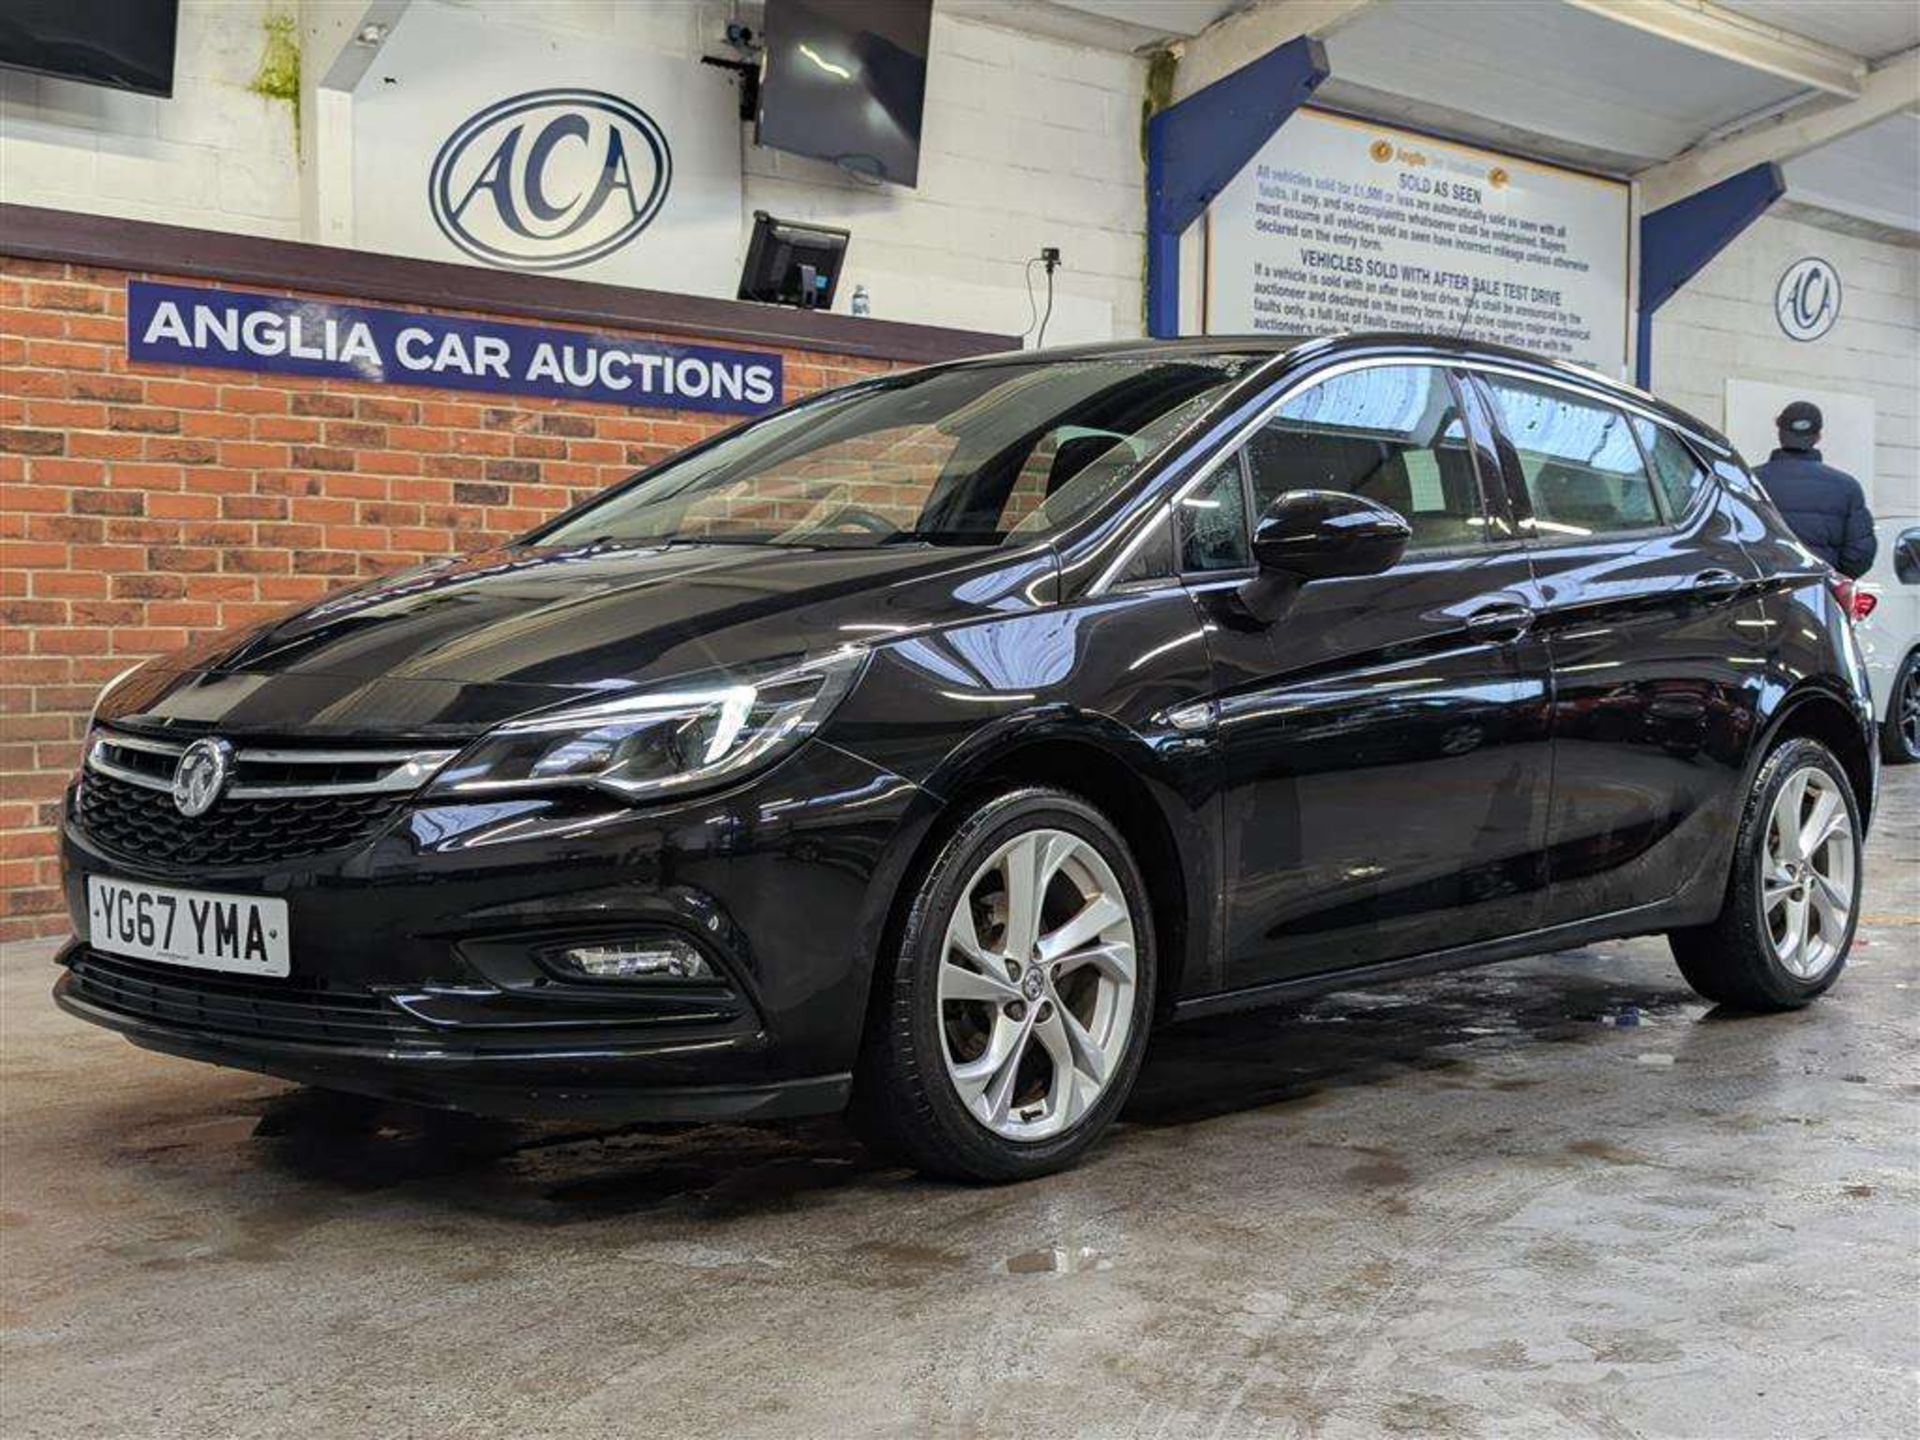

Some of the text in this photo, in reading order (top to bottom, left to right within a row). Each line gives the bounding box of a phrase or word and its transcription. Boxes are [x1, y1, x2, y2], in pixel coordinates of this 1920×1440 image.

[451, 113, 641, 241] ACA
[1272, 170, 1312, 188] vehicles
[1315, 179, 1335, 191] sold
[1337, 181, 1351, 194] for
[1397, 191, 1415, 207] less
[1417, 200, 1430, 211] are
[1432, 203, 1486, 225] automatically
[1488, 213, 1506, 225] sold
[1507, 218, 1517, 228] as
[1520, 220, 1538, 232] seen
[1540, 224, 1555, 237] with
[1557, 225, 1566, 237] all
[1399, 172, 1482, 204] SOLD AS SEEN
[1256, 219, 1298, 236] declared
[1301, 228, 1313, 238] on
[1316, 228, 1330, 242] the
[1333, 231, 1357, 249] entry
[1256, 202, 1589, 272] must assume all vehicles sold as seen have incorrect mileage unless otherwise
[1292, 189, 1299, 201] if
[1323, 196, 1341, 210] and
[1343, 201, 1355, 213] no
[1357, 204, 1405, 222] complaints
[1408, 213, 1456, 231] whatsoever
[1459, 222, 1478, 235] shall
[1479, 227, 1490, 238] be
[1254, 261, 1262, 275] If
[1265, 267, 1271, 277] a
[1273, 268, 1307, 283] vehicle
[1309, 272, 1318, 284] is
[1321, 275, 1341, 287] sold
[1343, 278, 1363, 291] with
[1365, 282, 1377, 293] an
[1379, 282, 1398, 297] after
[1401, 287, 1418, 300] sale
[1420, 289, 1437, 302] test
[1482, 299, 1501, 312] shall
[1503, 303, 1513, 314] be
[1515, 306, 1557, 321] announced
[1558, 312, 1567, 325] by
[1569, 312, 1581, 324] the
[1301, 248, 1561, 306] VEHICLES SOLD WITH AFTER SALE TEST DRIVE
[1254, 282, 1306, 299] auctioneer
[1309, 291, 1326, 303] and
[1328, 292, 1369, 309] declared
[1371, 300, 1382, 310] on
[1384, 300, 1397, 313] the
[1400, 304, 1421, 319] entry
[1449, 309, 1454, 320] A
[1475, 313, 1495, 326] drive
[1497, 319, 1524, 331] covers
[1526, 322, 1547, 335] major
[1549, 326, 1591, 340] mechanical
[1254, 297, 1281, 313] faults
[1310, 307, 1315, 318] a
[1318, 306, 1333, 319] full
[1335, 307, 1349, 322] list
[1351, 311, 1361, 324] of
[1363, 314, 1387, 328] faults
[1527, 338, 1542, 349] and
[1543, 339, 1558, 351] with
[1560, 342, 1573, 352] the
[143, 301, 774, 404] ANGLIA CAR AUCTIONS
[100, 885, 268, 962] YG67 YMA
